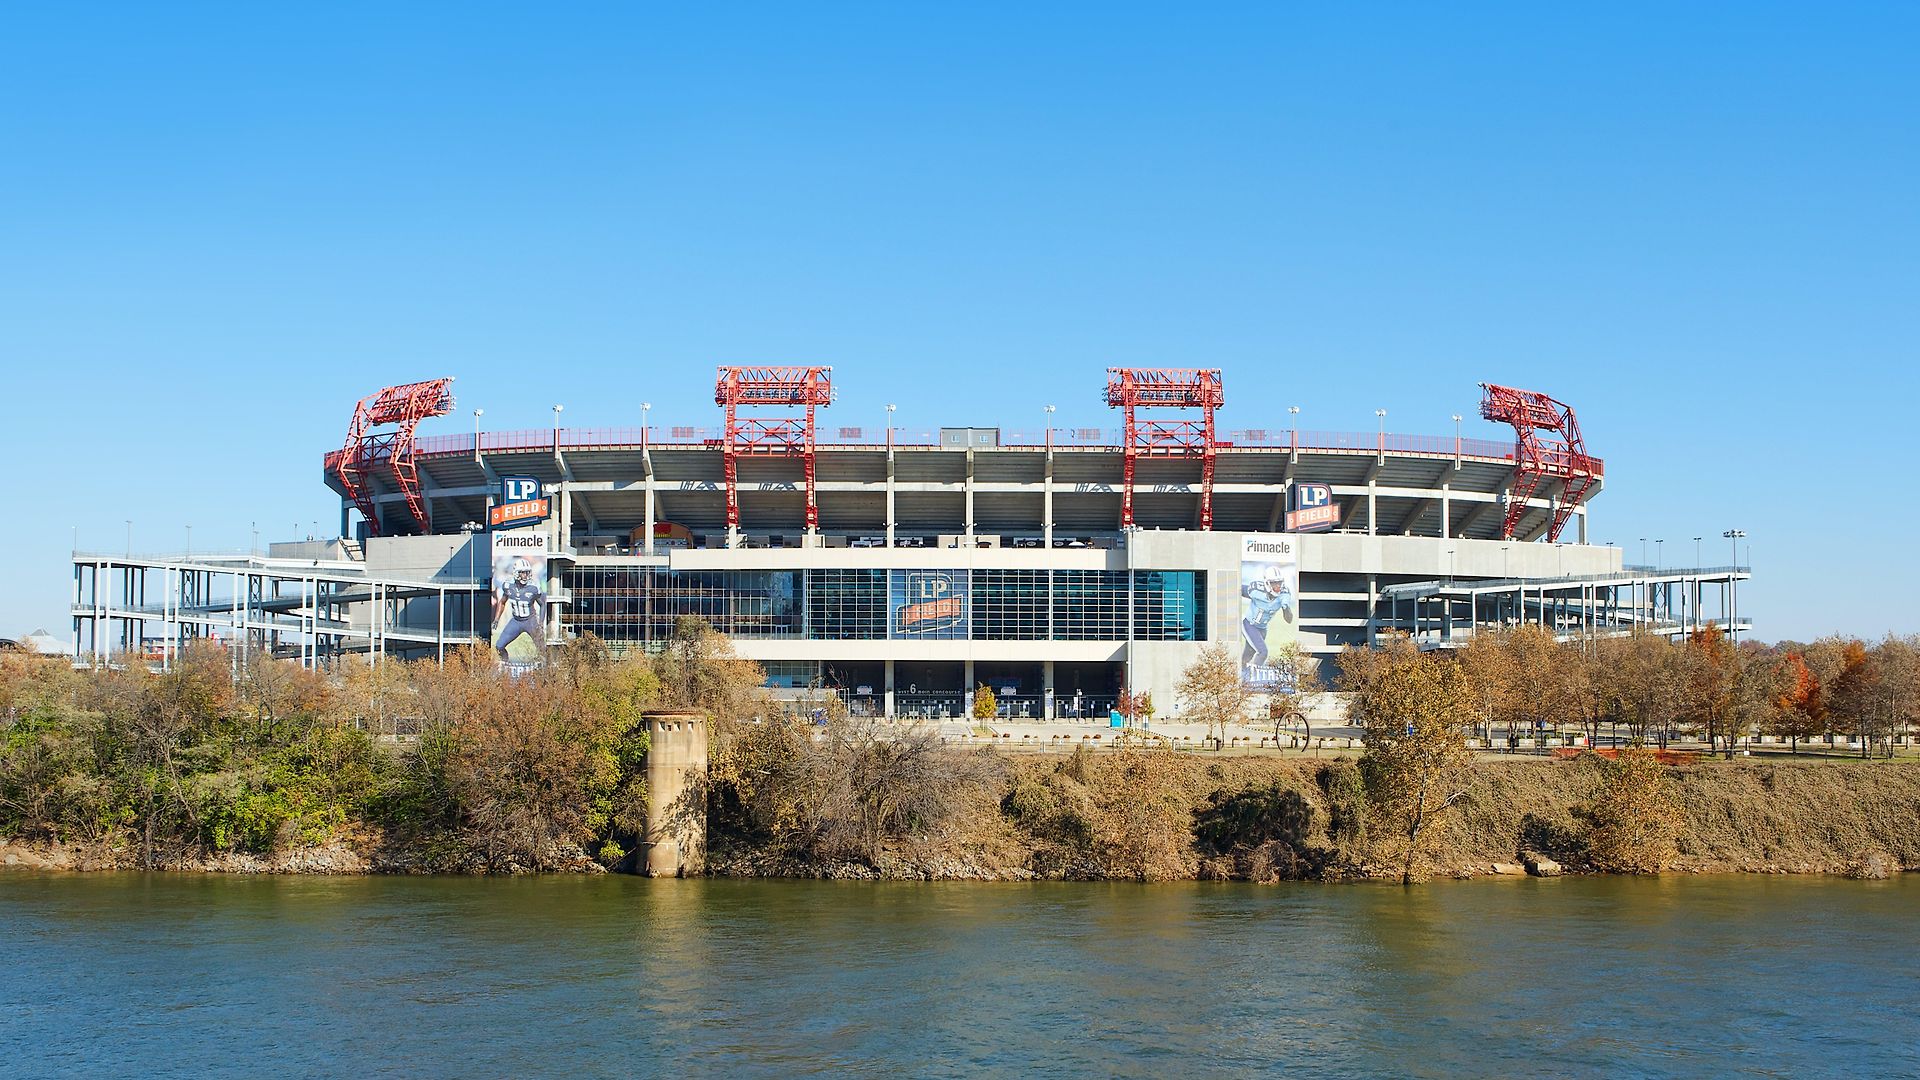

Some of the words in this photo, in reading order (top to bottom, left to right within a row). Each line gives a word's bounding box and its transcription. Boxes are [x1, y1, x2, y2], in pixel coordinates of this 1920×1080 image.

[504, 502, 540, 518] FIELD
[1299, 508, 1330, 523] FIELD
[496, 534, 543, 548] Pinnacle
[1247, 541, 1290, 554] Pinnacle
[909, 683, 917, 694] 6
